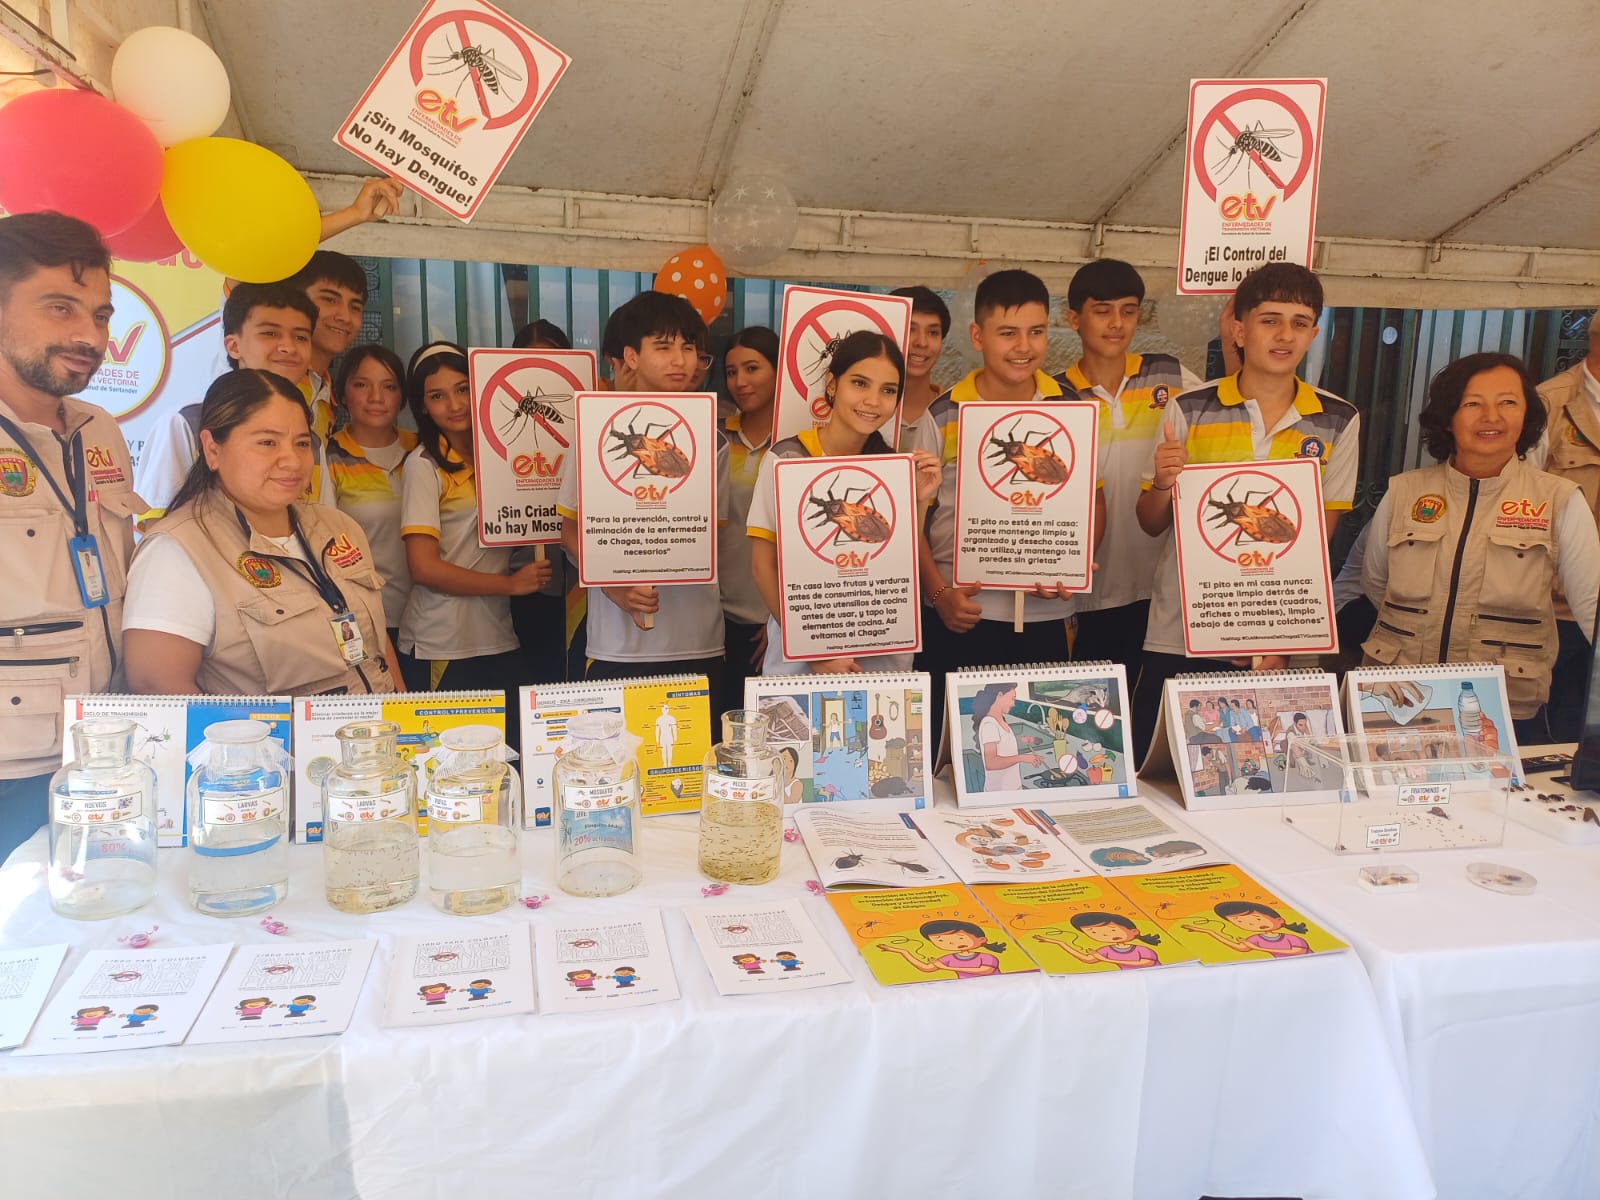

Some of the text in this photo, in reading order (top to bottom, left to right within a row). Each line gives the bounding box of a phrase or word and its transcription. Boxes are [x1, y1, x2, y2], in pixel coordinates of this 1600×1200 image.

[416, 89, 477, 132] etv
[363, 110, 397, 134] ¡Sin
[399, 129, 478, 187] Mosquitos
[349, 123, 473, 207] No hay Dengue!
[1220, 192, 1277, 220] etv
[1205, 246, 1286, 264] ¡El Control del
[1186, 267, 1228, 286] Dengue
[1232, 267, 1242, 282] lo
[126, 371, 140, 380] DE
[98, 378, 139, 387] VECTORIAL
[512, 452, 564, 477] etv
[634, 484, 668, 500] etv
[1010, 490, 1045, 506] etv
[498, 506, 521, 522] ¡Sin
[1501, 500, 1547, 518] etv
[622, 516, 670, 524] prevención,
[672, 514, 700, 522] control
[980, 518, 997, 526] pito
[1012, 518, 1030, 526] está
[485, 521, 502, 535] No
[506, 522, 528, 536] hay
[586, 526, 632, 534] eliminación
[968, 528, 996, 536] porque
[998, 528, 1040, 536] mantengo
[1042, 528, 1067, 537] limpio
[610, 538, 642, 546] Chagas,
[964, 536, 1010, 545] organizado
[1018, 537, 1052, 546] desecho
[1024, 548, 1066, 556] mantengo
[835, 551, 870, 568] etv
[1237, 550, 1274, 566] etv
[824, 580, 841, 588] lavo
[843, 580, 867, 588] frutas
[876, 577, 910, 586] verduras
[1214, 582, 1230, 590] pito
[788, 592, 810, 601] antes
[824, 590, 873, 599] consumirlos,
[874, 588, 899, 596] hiervo
[1236, 590, 1263, 598] limpio
[1266, 588, 1294, 596] detrás
[789, 604, 812, 612] agua,
[814, 602, 831, 610] lavo
[833, 600, 870, 608] utensilios
[1192, 601, 1224, 609] objetos
[1241, 600, 1277, 608] paredes
[1280, 598, 1322, 606] (cuadros,
[838, 611, 857, 619] usar,
[866, 609, 884, 618] tapo
[1200, 610, 1231, 618] afiches
[1242, 608, 1285, 617] muebles),
[1288, 607, 1315, 615] limpio
[802, 622, 843, 630] elementos
[858, 618, 884, 627] cocina.
[886, 617, 898, 625] Así
[1190, 620, 1220, 629] debajo
[810, 632, 846, 640] evitamos
[238, 800, 258, 808] LARVAS
